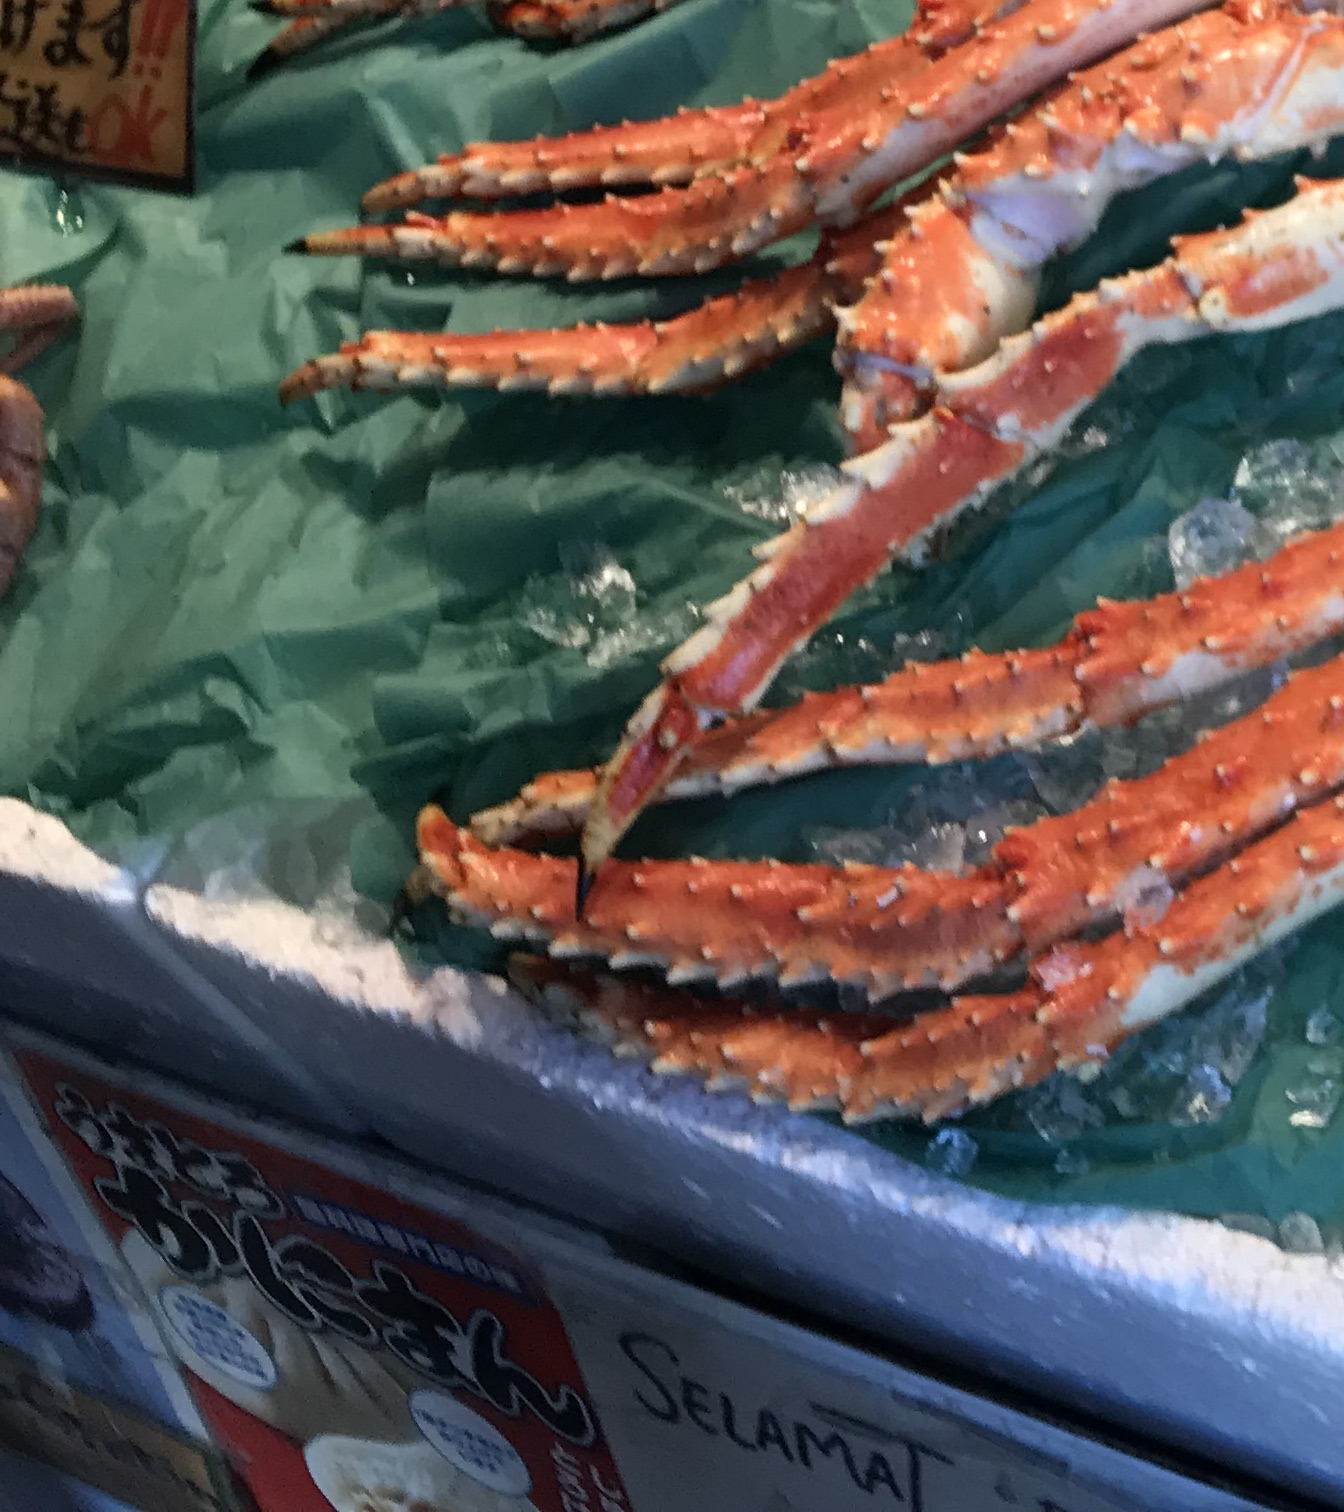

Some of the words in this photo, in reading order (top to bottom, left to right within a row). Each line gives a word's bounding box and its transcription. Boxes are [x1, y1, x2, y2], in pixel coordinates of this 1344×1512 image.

[93, 1165, 599, 1448] かにまん
[618, 1330, 955, 1512] SELAMAT
